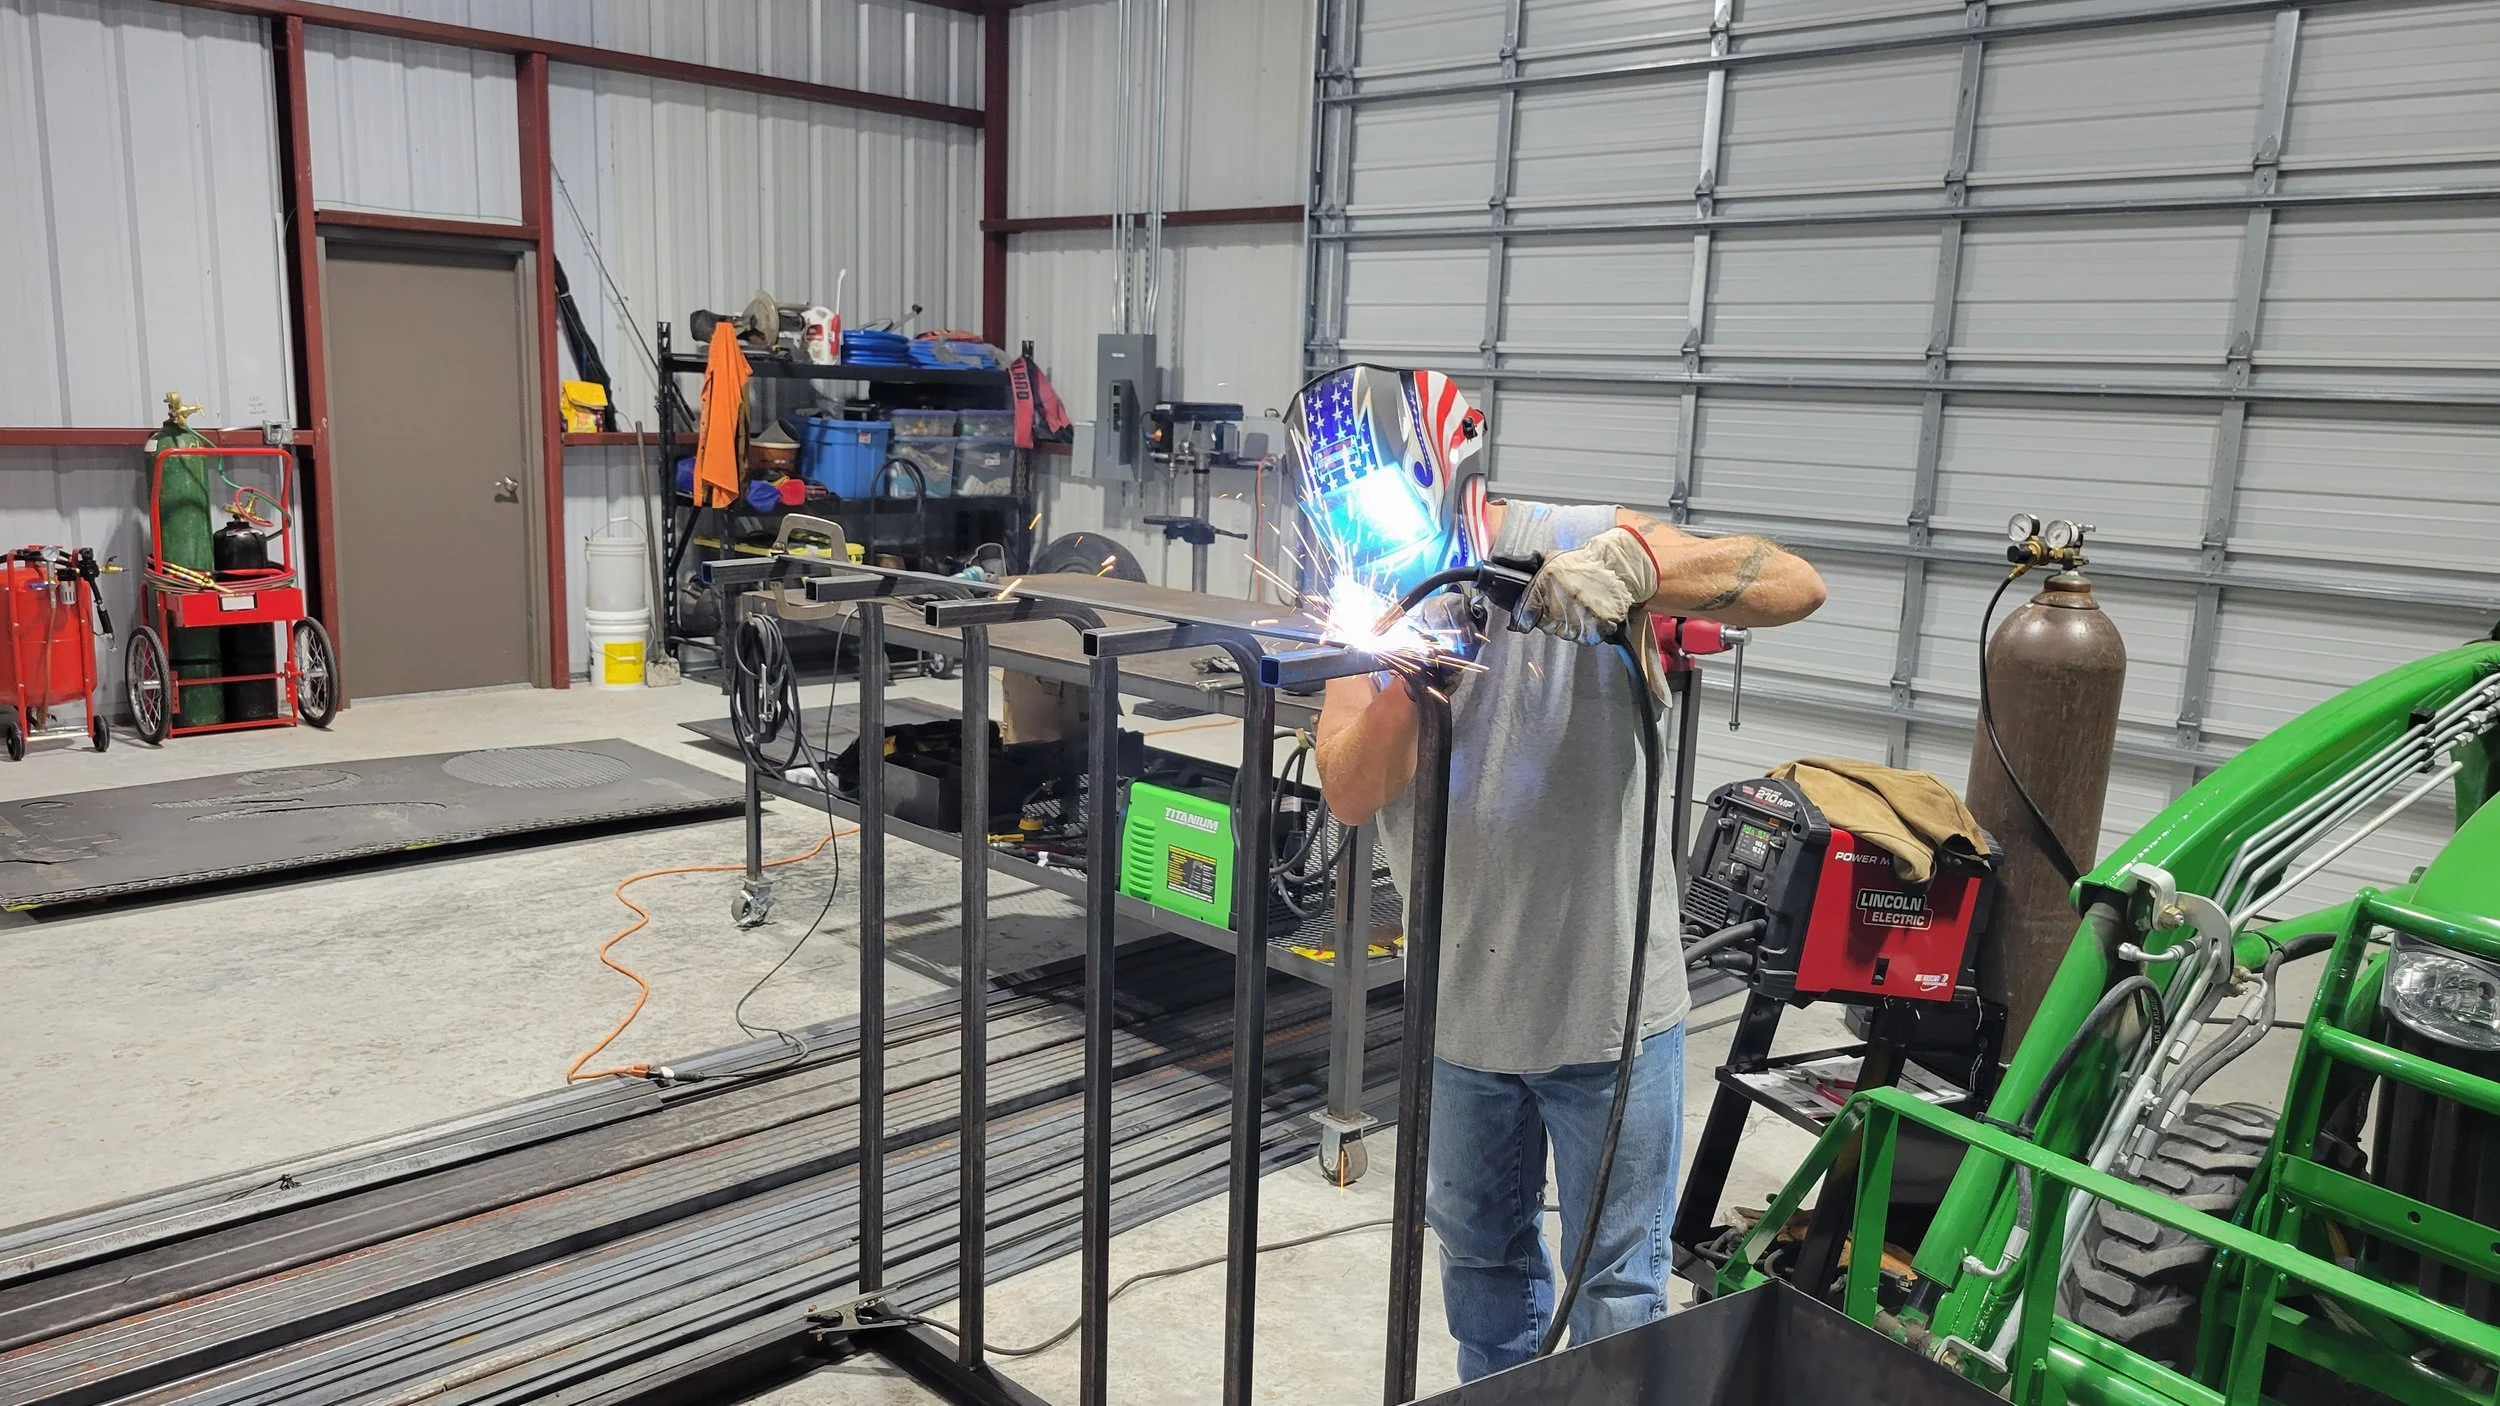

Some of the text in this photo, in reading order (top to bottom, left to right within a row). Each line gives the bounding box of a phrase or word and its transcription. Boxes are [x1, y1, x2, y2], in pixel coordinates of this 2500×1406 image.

[1755, 789, 1779, 803] 210
[1165, 807, 1219, 831] TITANIUM
[1834, 851, 1877, 864] POWER
[1860, 892, 1922, 911] LINCOLN
[1871, 911, 1925, 926] ELECTRIC
